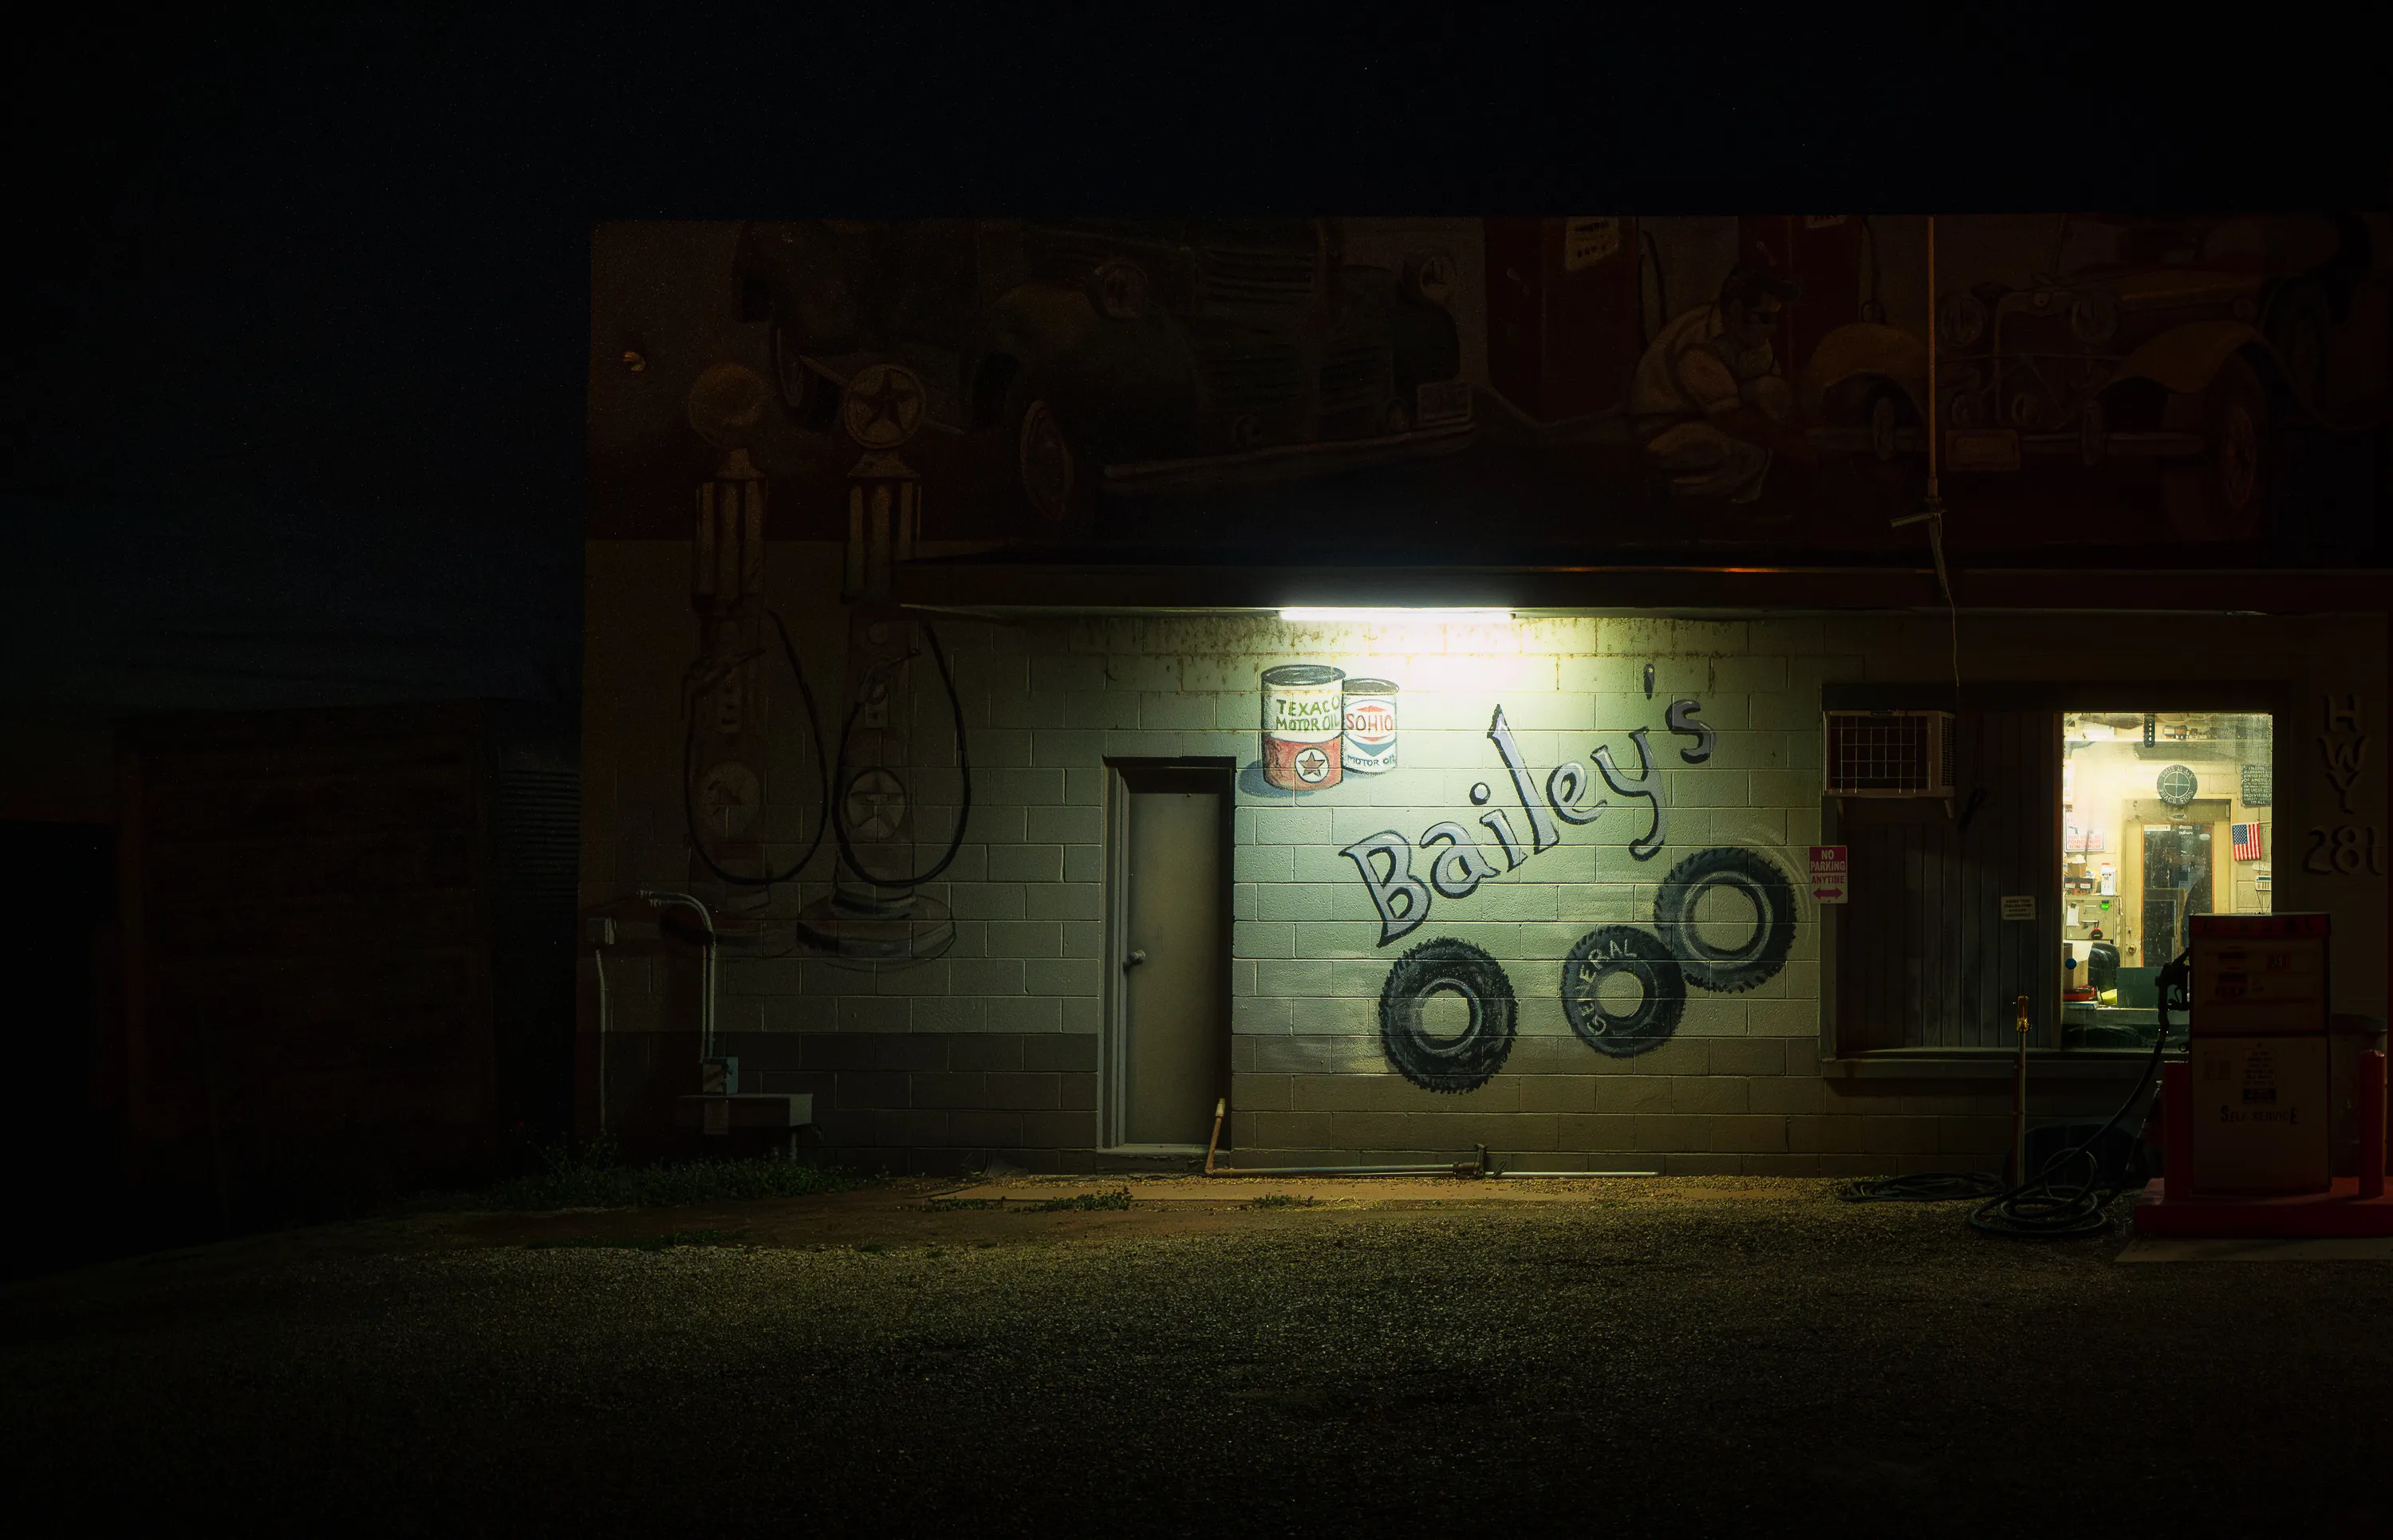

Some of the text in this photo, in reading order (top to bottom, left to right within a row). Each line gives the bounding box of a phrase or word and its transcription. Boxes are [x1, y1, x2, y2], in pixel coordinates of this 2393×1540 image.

[1276, 695, 1341, 716] TEXACO
[1276, 715, 1341, 731] MOTOR OIL
[1346, 713, 1394, 733] SOHIO
[1347, 755, 1379, 767] MOTOR
[1338, 663, 1717, 948] Bailey's
[1821, 849, 1835, 861] NO
[2302, 825, 2385, 876] 281
[1810, 861, 1846, 872] PARKING
[1812, 875, 1845, 884] ANYTIME
[1574, 938, 1638, 1036] GENERAL
